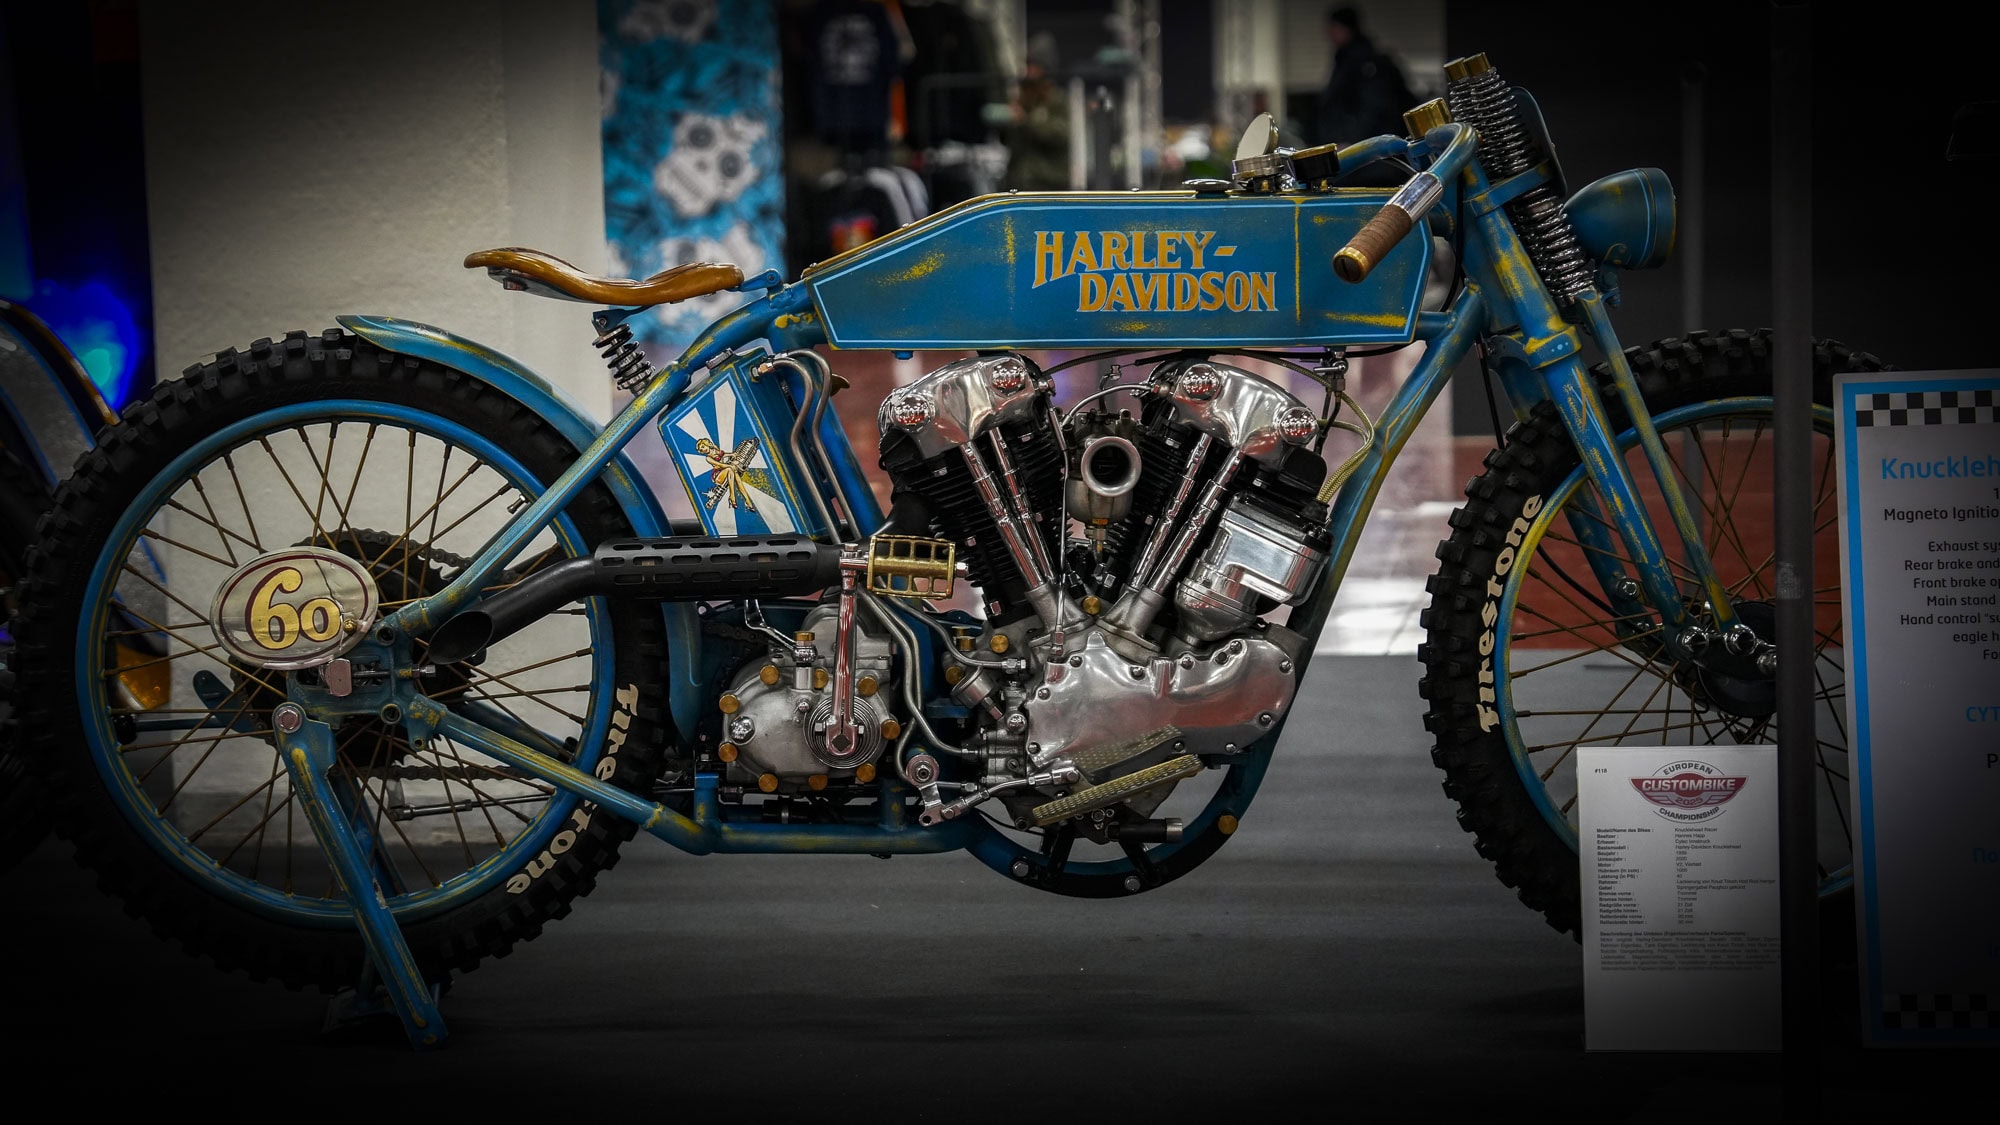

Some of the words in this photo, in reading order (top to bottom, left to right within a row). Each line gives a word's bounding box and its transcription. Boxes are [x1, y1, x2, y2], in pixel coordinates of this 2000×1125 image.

[1032, 231, 1237, 289] HARLEY-
[1076, 271, 1279, 312] DAVIDSON
[1884, 508, 1948, 523] Magneto
[1953, 505, 1999, 522] Ignitio
[1928, 541, 1980, 552] Exhaust
[1983, 542, 2000, 553] sy
[1904, 559, 1934, 571] Rear
[1937, 558, 1973, 570] brake
[1976, 557, 2000, 569] and
[1913, 577, 1946, 589] Front
[1950, 576, 1986, 588] brake
[1927, 595, 1957, 606] Main
[1960, 594, 1996, 606] stand
[245, 566, 341, 650] 60
[1476, 494, 1543, 733] Firestone
[1900, 613, 1934, 625] Hand
[1937, 612, 1981, 624] control
[1953, 630, 1988, 645] eagle
[1663, 762, 1713, 775] EUROPEAN
[1642, 779, 1736, 791] CUSTOMBIKE
[1659, 806, 1720, 821] CHAMPIONSHIP
